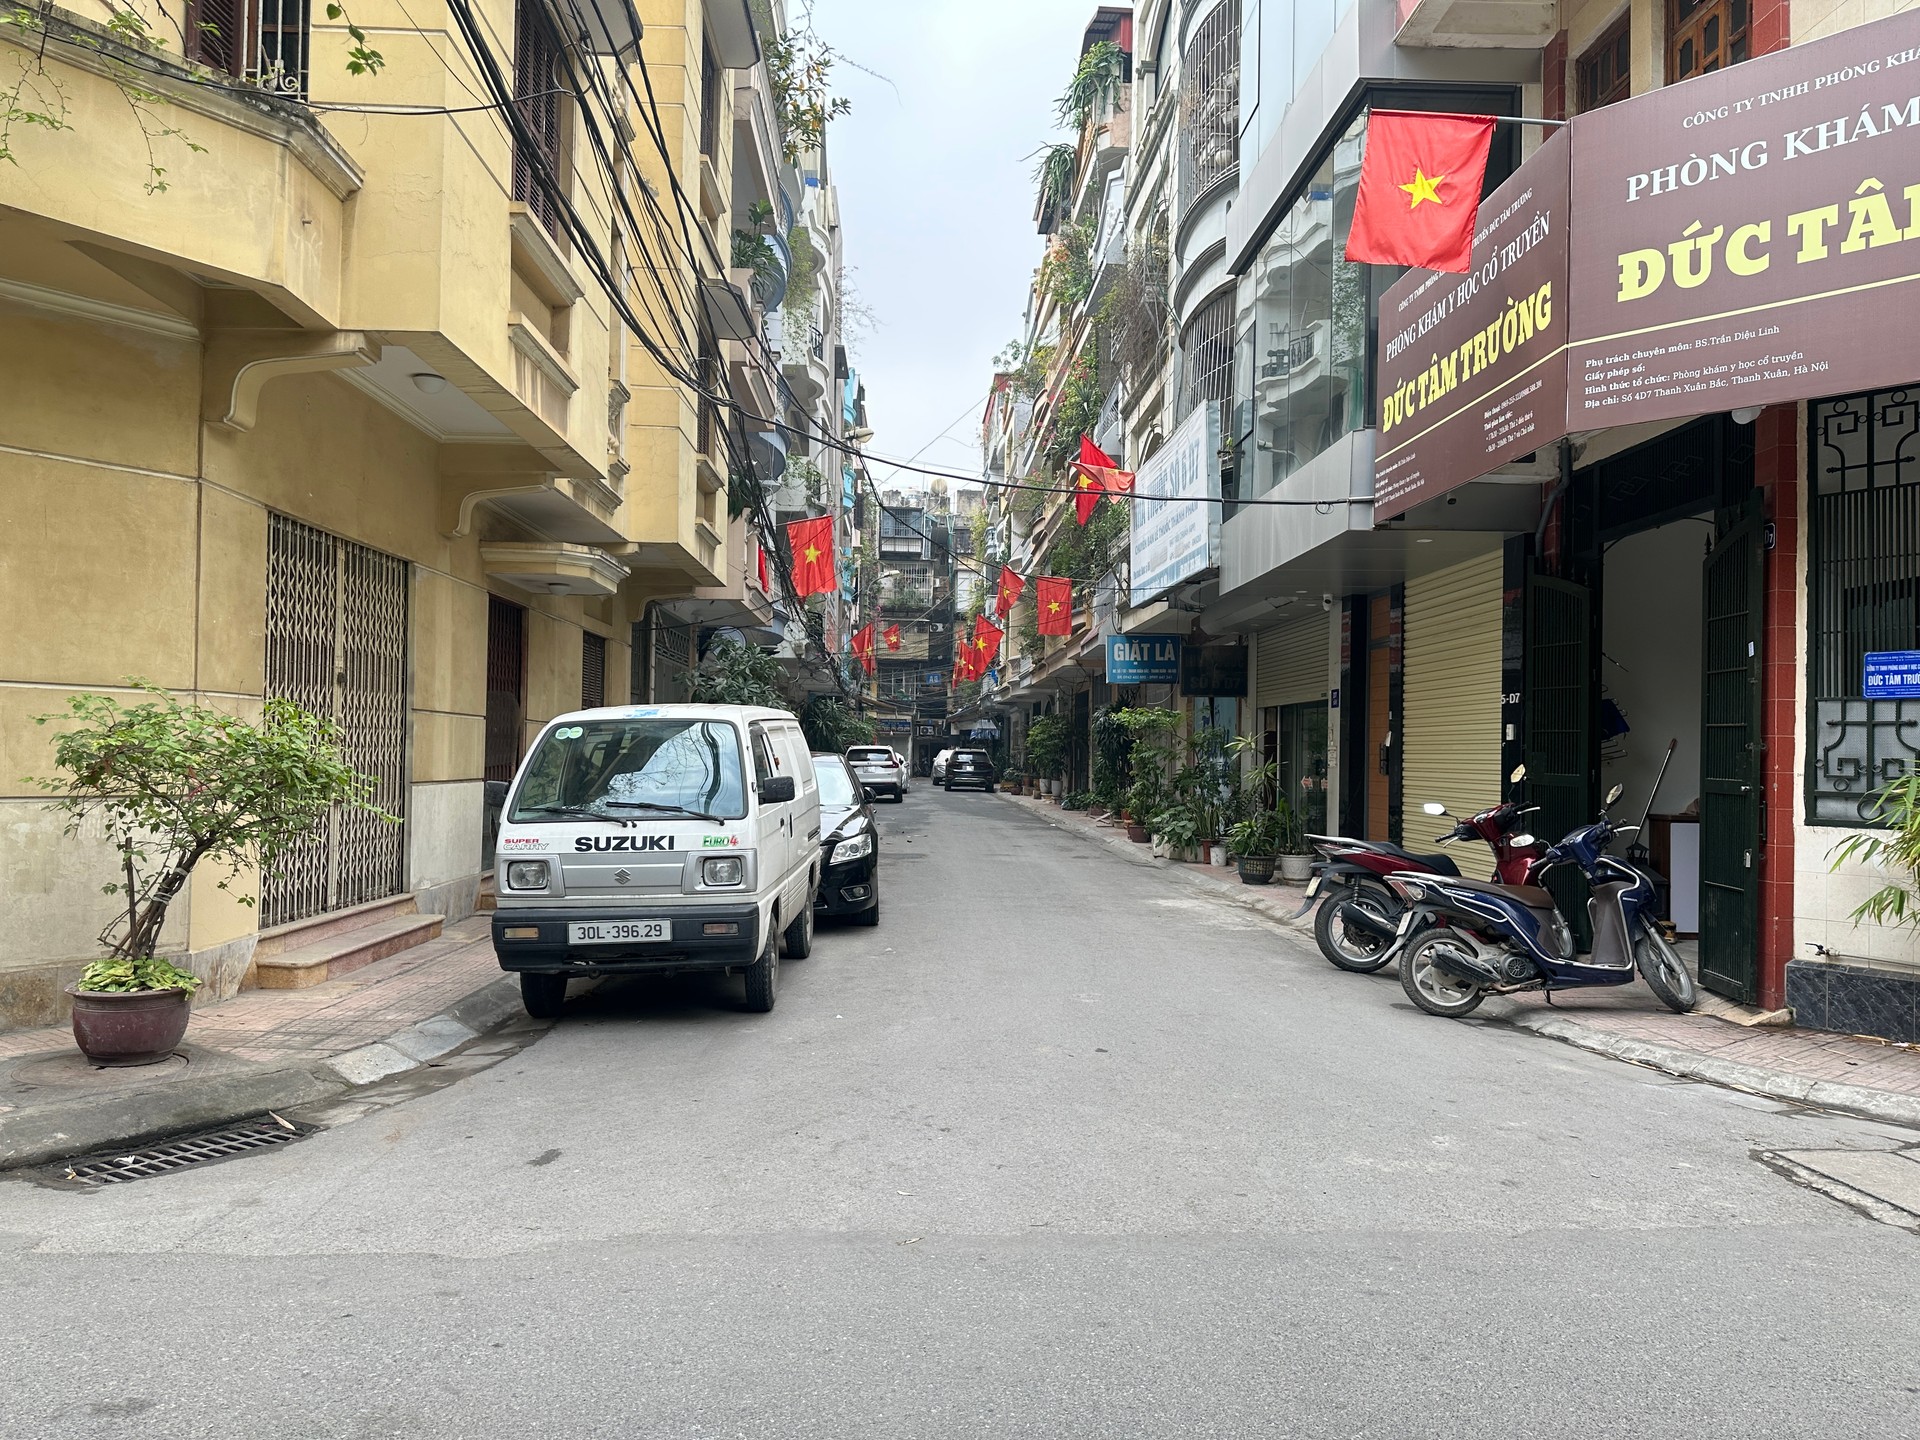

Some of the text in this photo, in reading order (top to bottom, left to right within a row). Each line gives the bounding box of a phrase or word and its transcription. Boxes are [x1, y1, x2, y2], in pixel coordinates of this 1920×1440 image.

[1683, 105, 1729, 129] CÔNG
[1733, 98, 1754, 114] TY
[1758, 81, 1809, 107] TNHH
[1814, 59, 1881, 90] PHÒNG
[1626, 96, 1920, 203] PHÒNG KHÁM
[1617, 219, 1771, 302] ĐỨC
[1386, 210, 1550, 362] PHÒNG KHÁM Y HỌC CỔ TRUYỀN
[1382, 377, 1415, 434] ĐỨC
[1418, 352, 1458, 411] TÂM
[1461, 281, 1552, 383] TRƯỜNG
[1585, 359, 1603, 368] Phụ
[1605, 353, 1630, 364] trách
[1632, 347, 1666, 360] chuyên
[1668, 343, 1693, 353] môn:
[1734, 330, 1756, 341] Diệu
[1758, 325, 1780, 336] Linh
[1585, 363, 1646, 381] Giấy phép số:
[1585, 384, 1607, 395] Hình
[1609, 380, 1630, 391] thức
[1633, 377, 1643, 387] tổ
[1645, 374, 1670, 385] chức:
[1673, 370, 1700, 380] Phòng
[1703, 364, 1728, 375] khám
[1730, 363, 1737, 372] y
[1739, 359, 1755, 370] học
[1585, 361, 1829, 409] Địa chỉ: Số 4D7 Thanh Xuân Bắc, Thanh Xuân, Hà Nội
[1113, 640, 1176, 665] GIẶT LÀ
[1868, 673, 1883, 686] ĐỨC
[1885, 673, 1901, 685] TÂM
[503, 843, 549, 851] CARRY
[574, 835, 675, 852] SUZUKI
[577, 924, 662, 940] 30L-396.29
